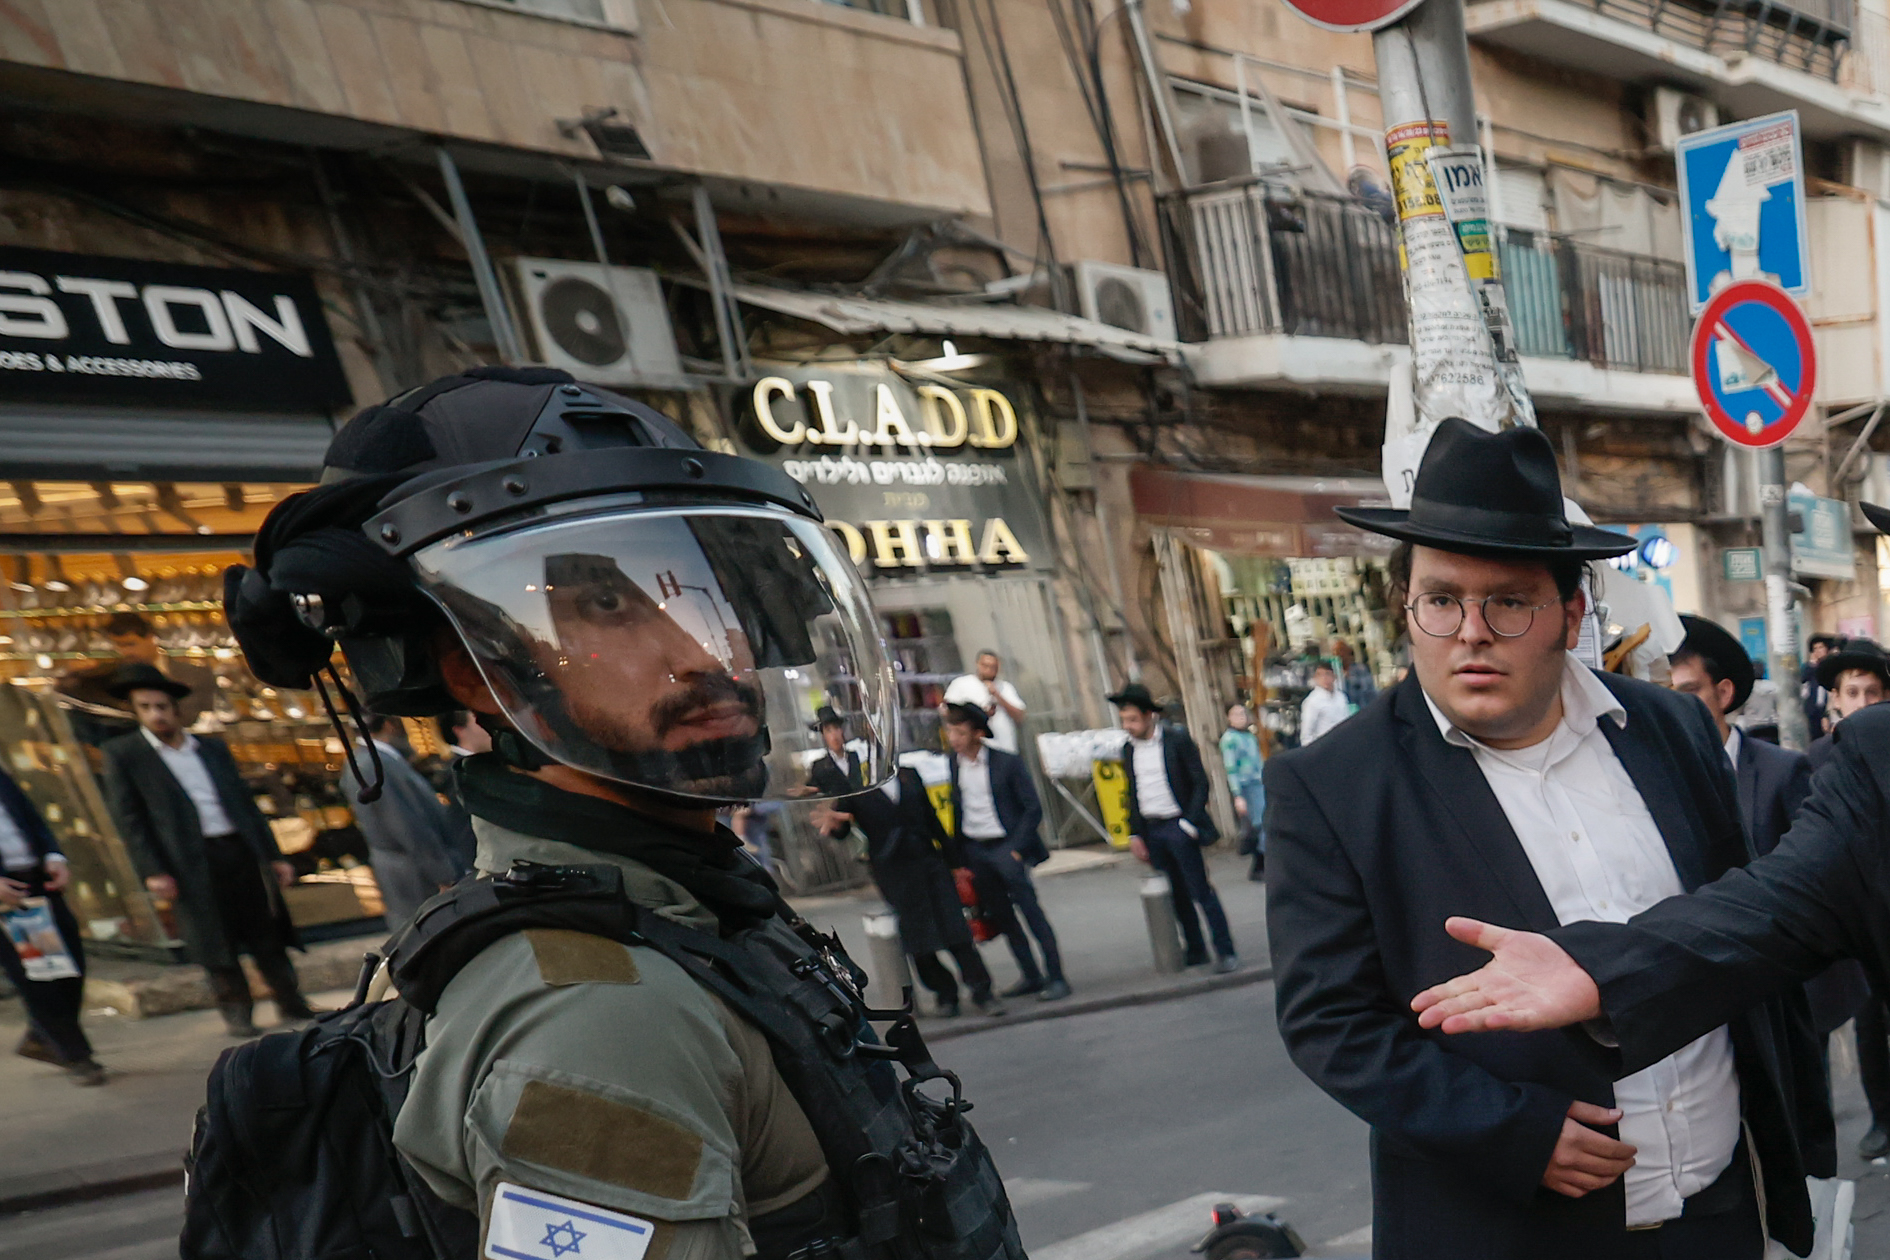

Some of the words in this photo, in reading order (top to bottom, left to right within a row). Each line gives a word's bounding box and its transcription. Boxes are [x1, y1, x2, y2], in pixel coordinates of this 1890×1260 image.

[45, 353, 65, 372] &
[66, 355, 203, 380] ACCESSORIES
[870, 457, 945, 485] לגברים
